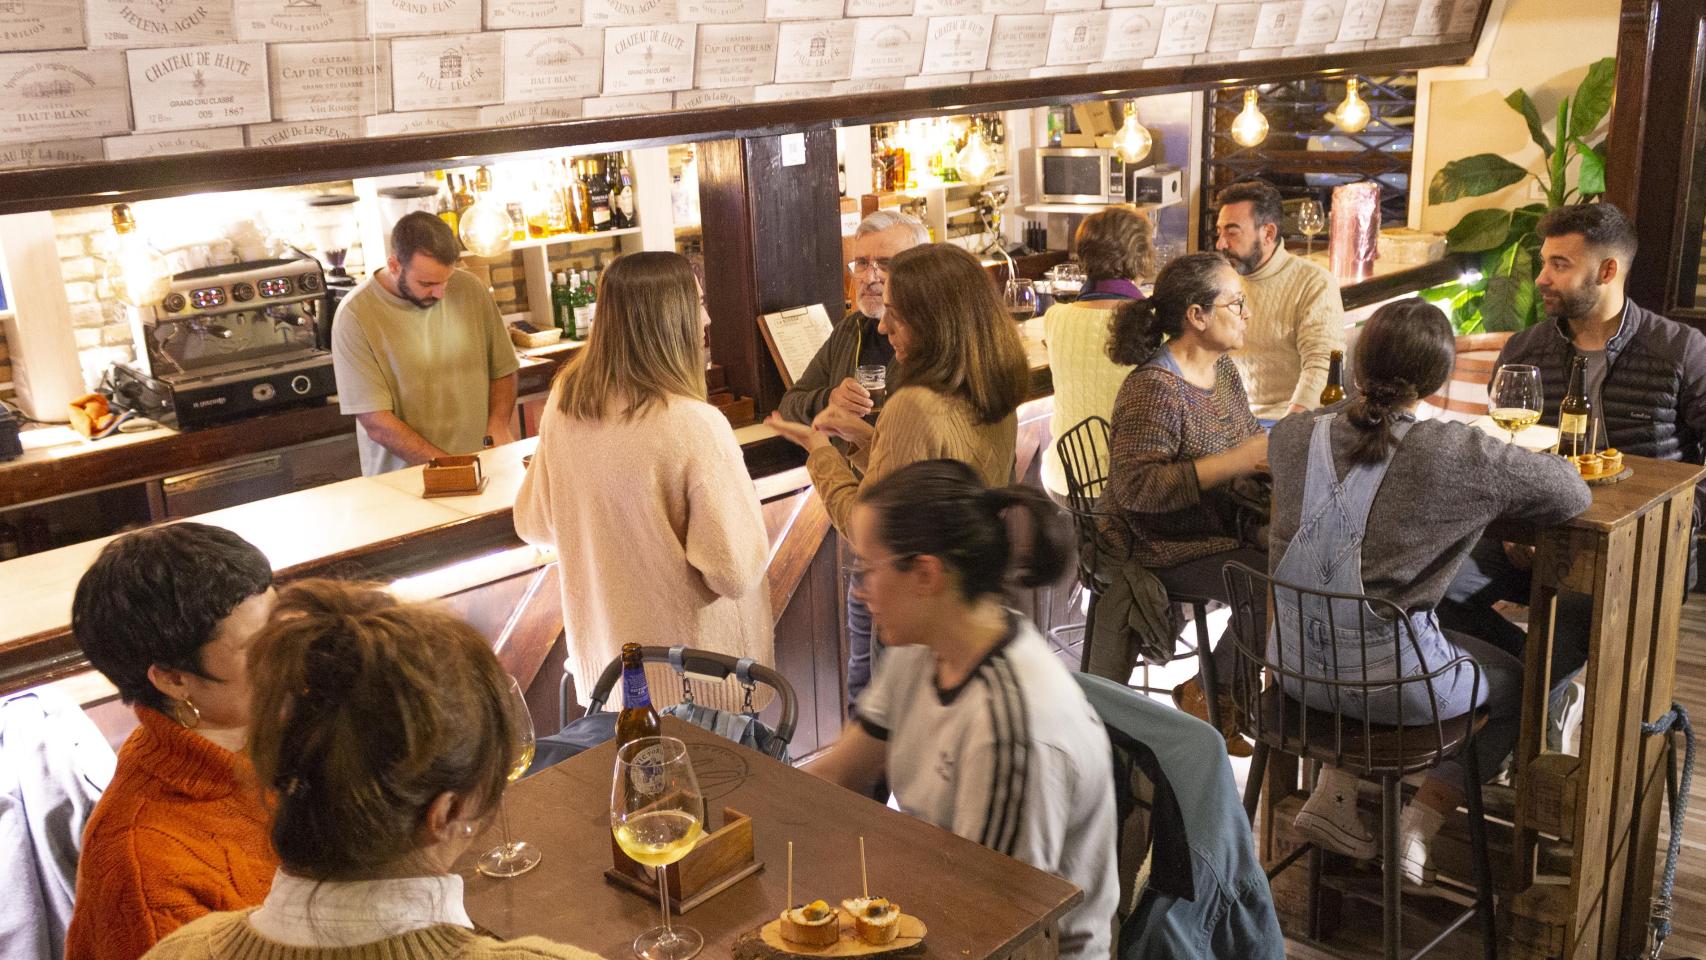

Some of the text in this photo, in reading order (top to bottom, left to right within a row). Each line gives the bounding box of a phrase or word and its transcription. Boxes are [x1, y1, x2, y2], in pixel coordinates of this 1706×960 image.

[120, 5, 208, 34] HELENA-AGUR
[144, 51, 251, 82] CHATEAU DE HAUTE
[16, 109, 92, 122] HAUT-BLANC
